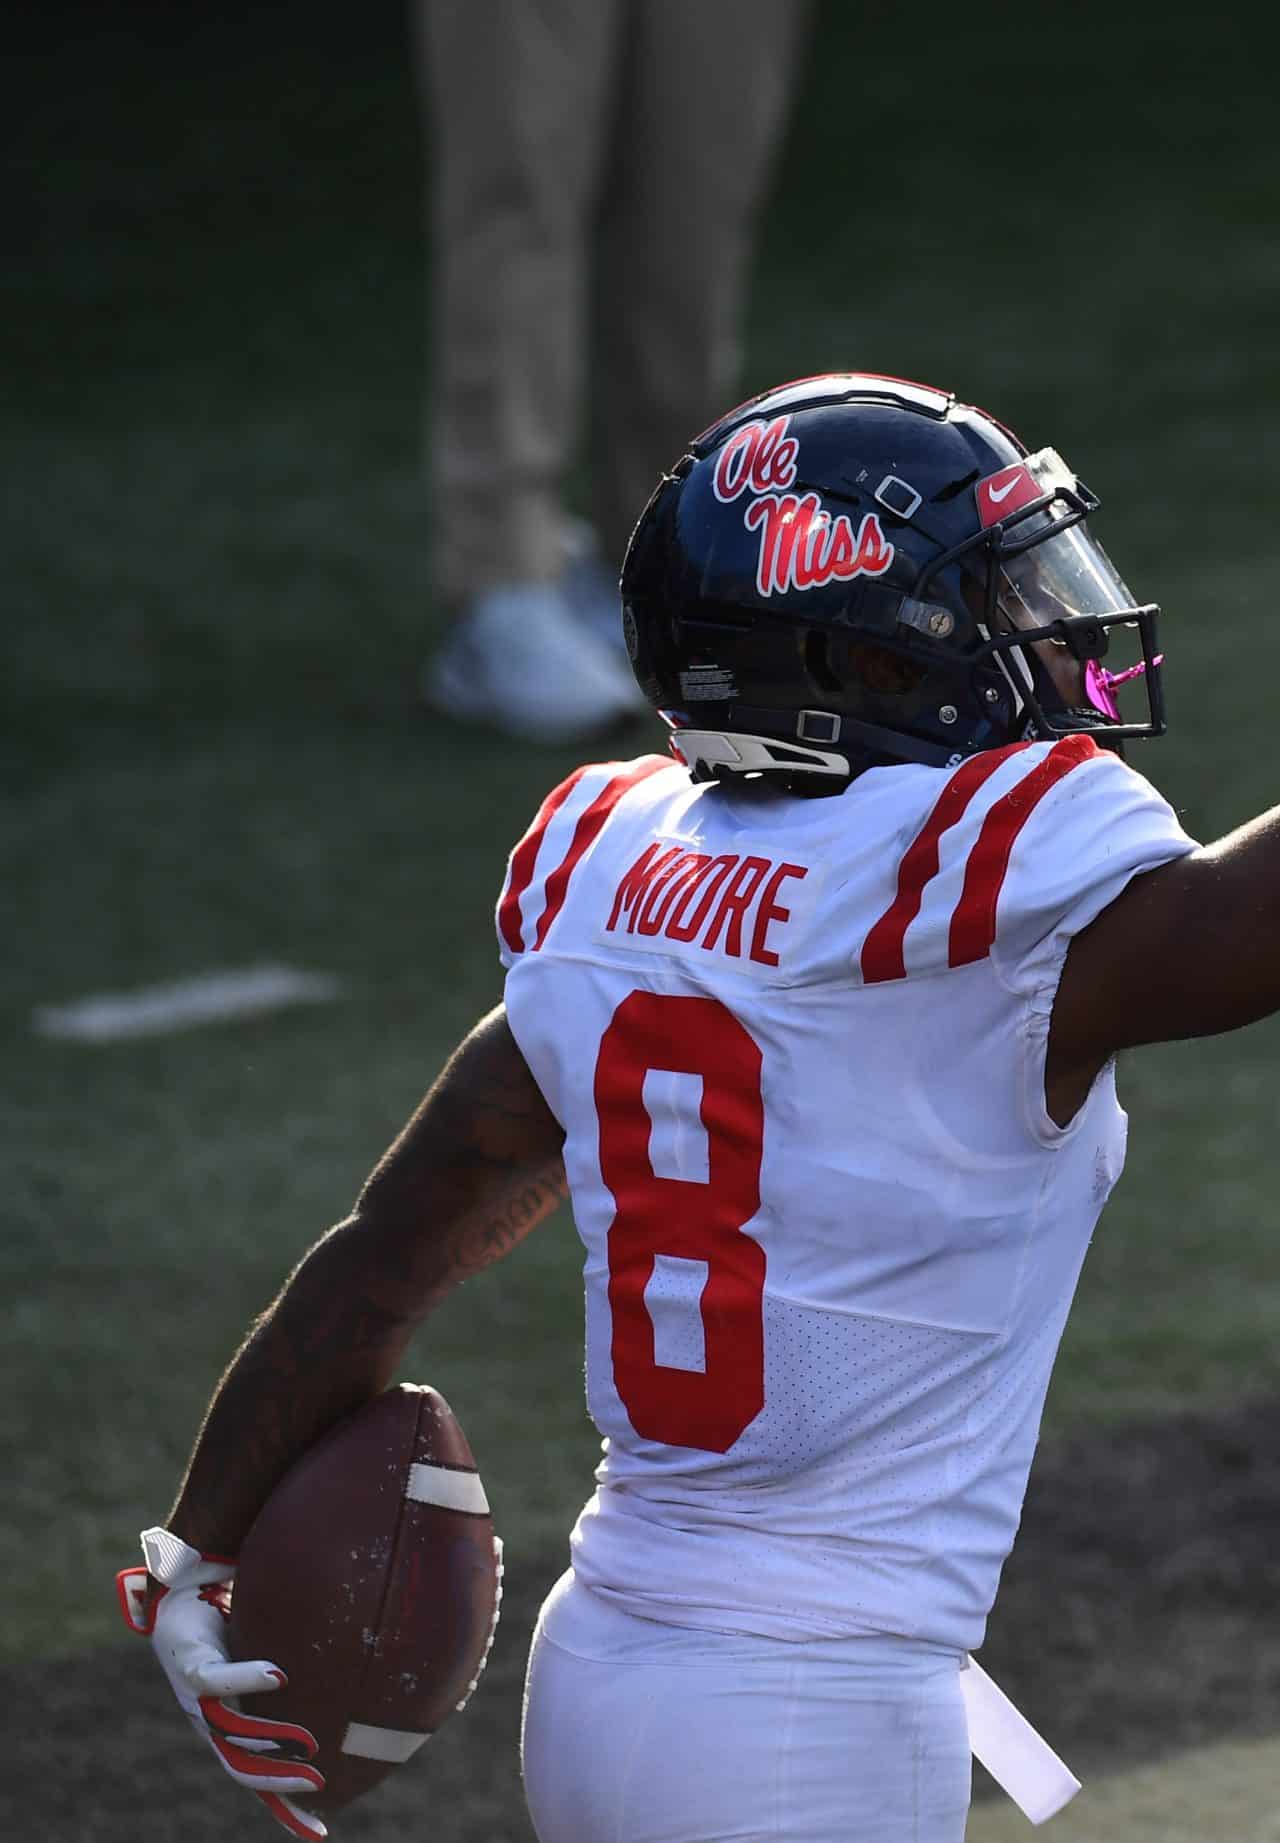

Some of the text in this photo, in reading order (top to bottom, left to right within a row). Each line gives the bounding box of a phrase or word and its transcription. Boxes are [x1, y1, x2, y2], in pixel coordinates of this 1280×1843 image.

[714, 415, 799, 502] Ole
[744, 493, 894, 597] Miss
[606, 842, 809, 967] MOORE
[593, 988, 767, 1455] 8
